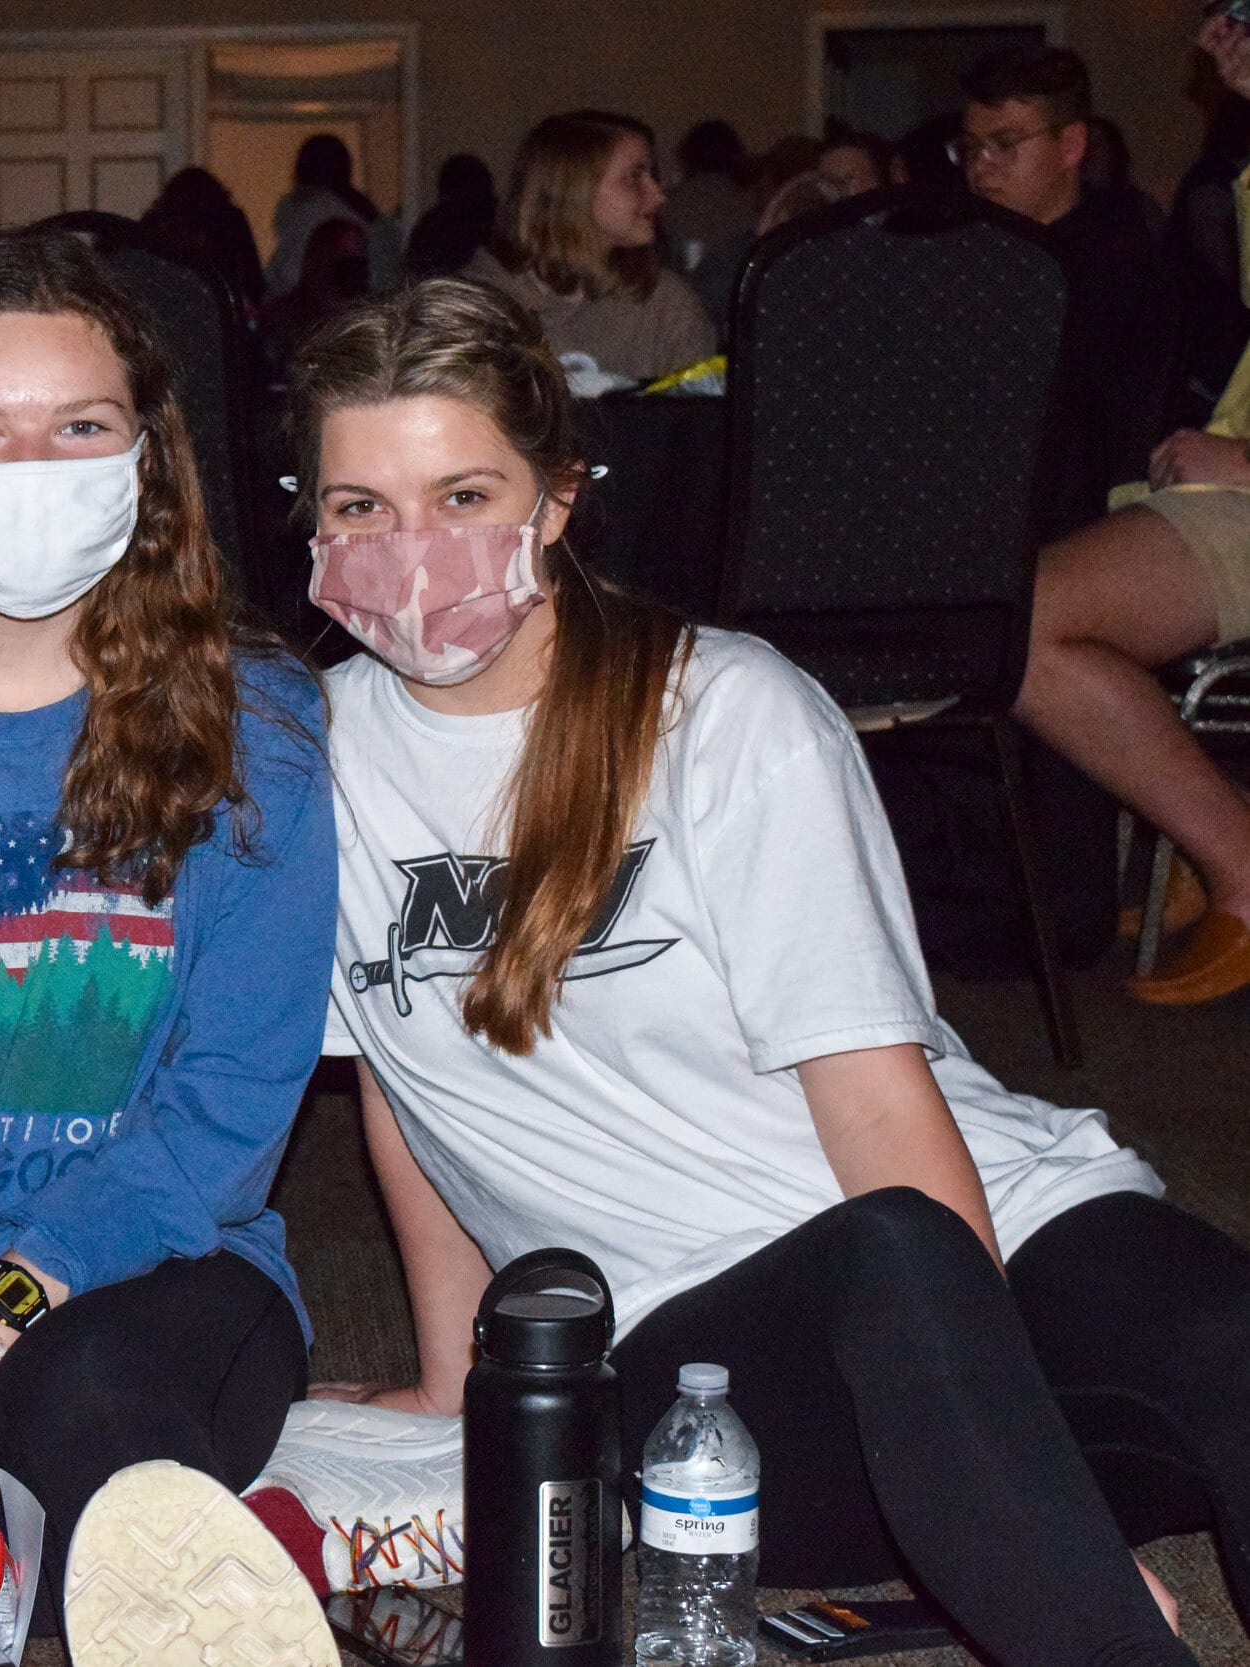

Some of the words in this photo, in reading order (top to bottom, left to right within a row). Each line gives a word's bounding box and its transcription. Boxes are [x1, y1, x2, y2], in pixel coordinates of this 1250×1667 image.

[52, 1112, 123, 1145] LOE
[675, 1519, 725, 1534] spring
[549, 1496, 573, 1635] GLACIER
